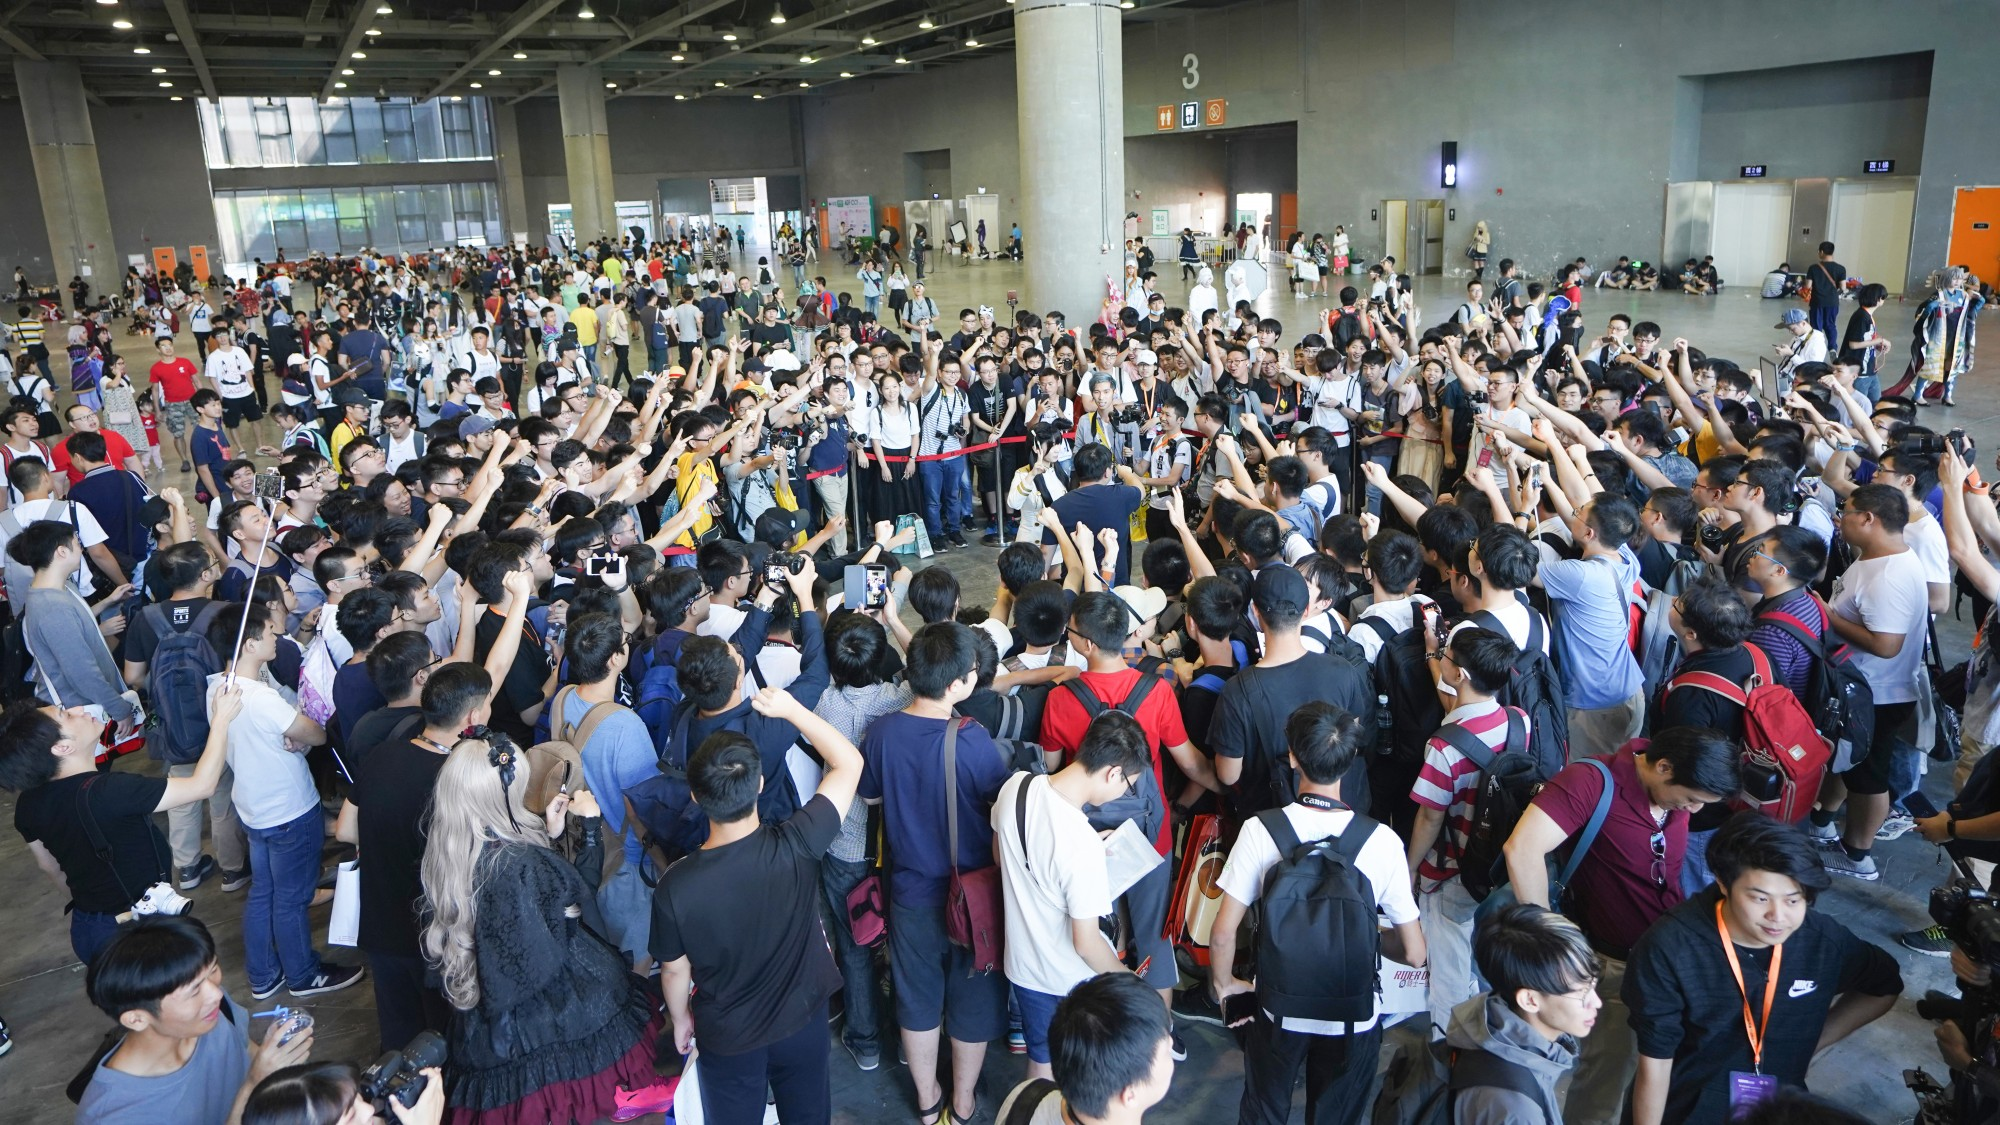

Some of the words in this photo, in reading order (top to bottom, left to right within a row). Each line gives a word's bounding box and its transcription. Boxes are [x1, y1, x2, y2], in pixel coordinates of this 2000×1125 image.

[1182, 53, 1200, 90] 3
[1302, 796, 1331, 808] Canon
[310, 975, 330, 988] N
[1792, 979, 1815, 990] NIKE
